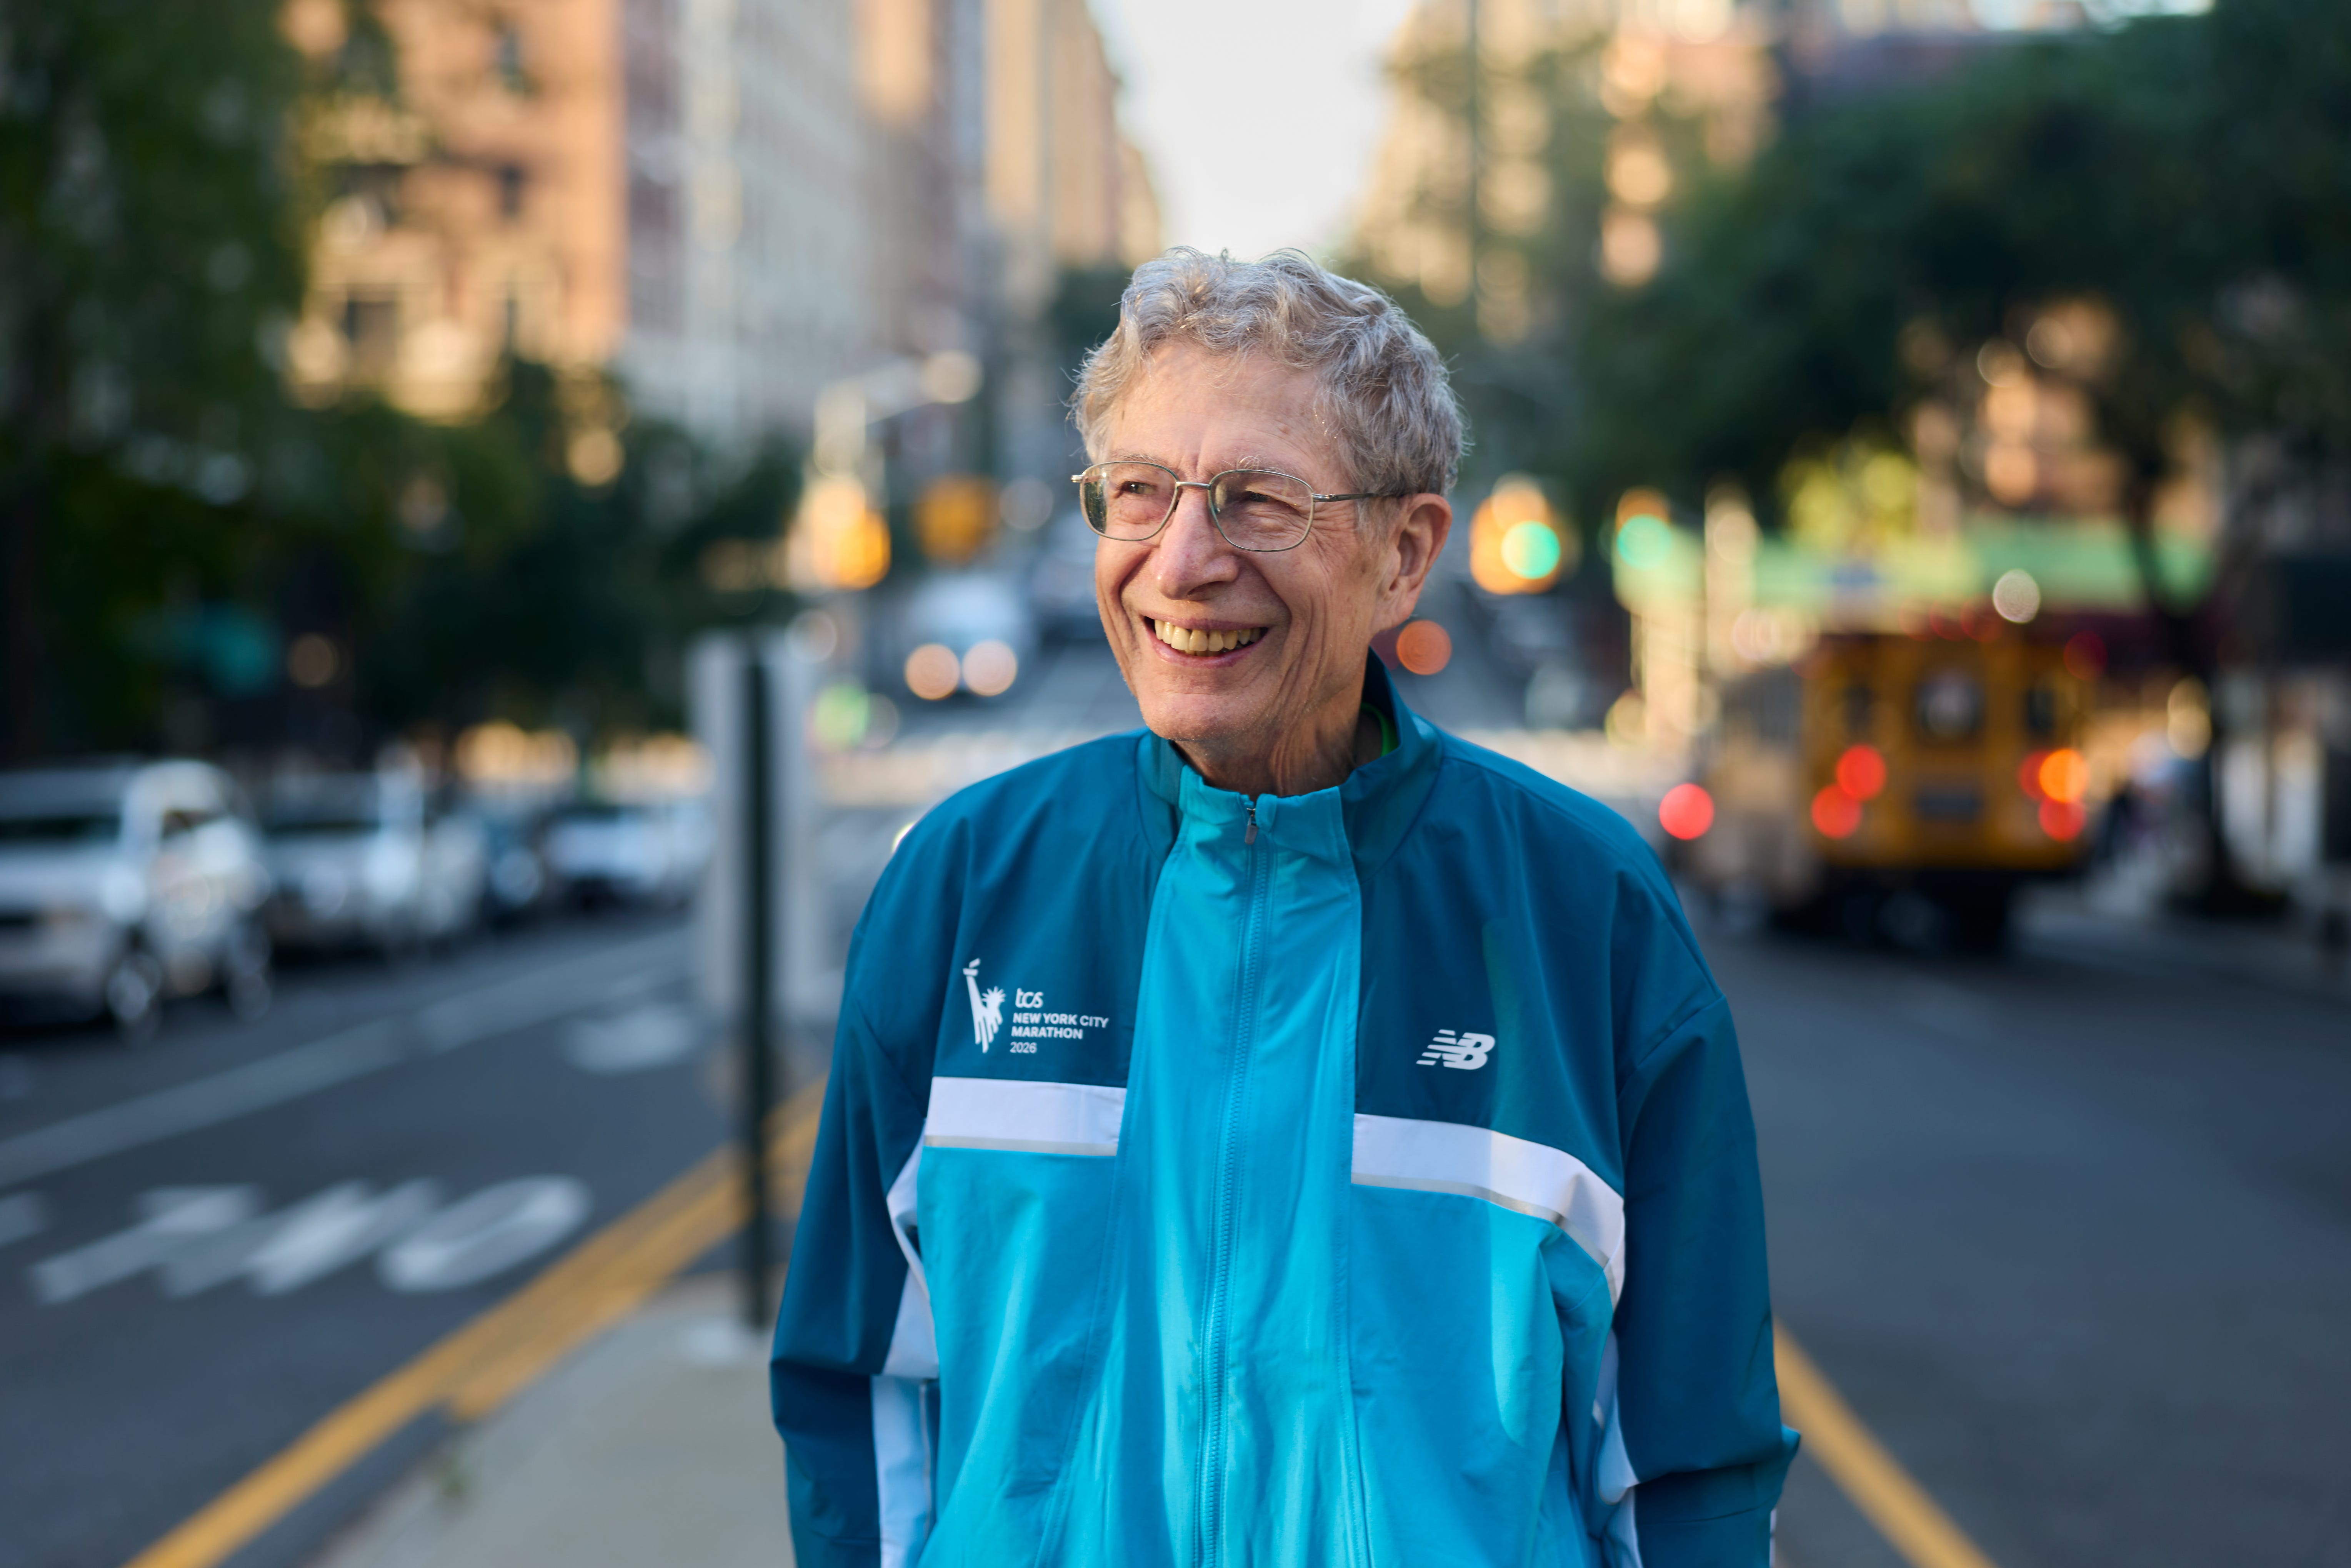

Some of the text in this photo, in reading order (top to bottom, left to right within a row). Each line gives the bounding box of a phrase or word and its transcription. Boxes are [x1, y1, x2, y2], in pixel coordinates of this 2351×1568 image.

[1015, 988, 1043, 1008] tcs
[1013, 1013, 1109, 1028] NEW YORK CITY
[1011, 1026, 1083, 1040] MARATHON
[1010, 1041, 1037, 1054] 2026
[1416, 1029, 1495, 1070] NB
